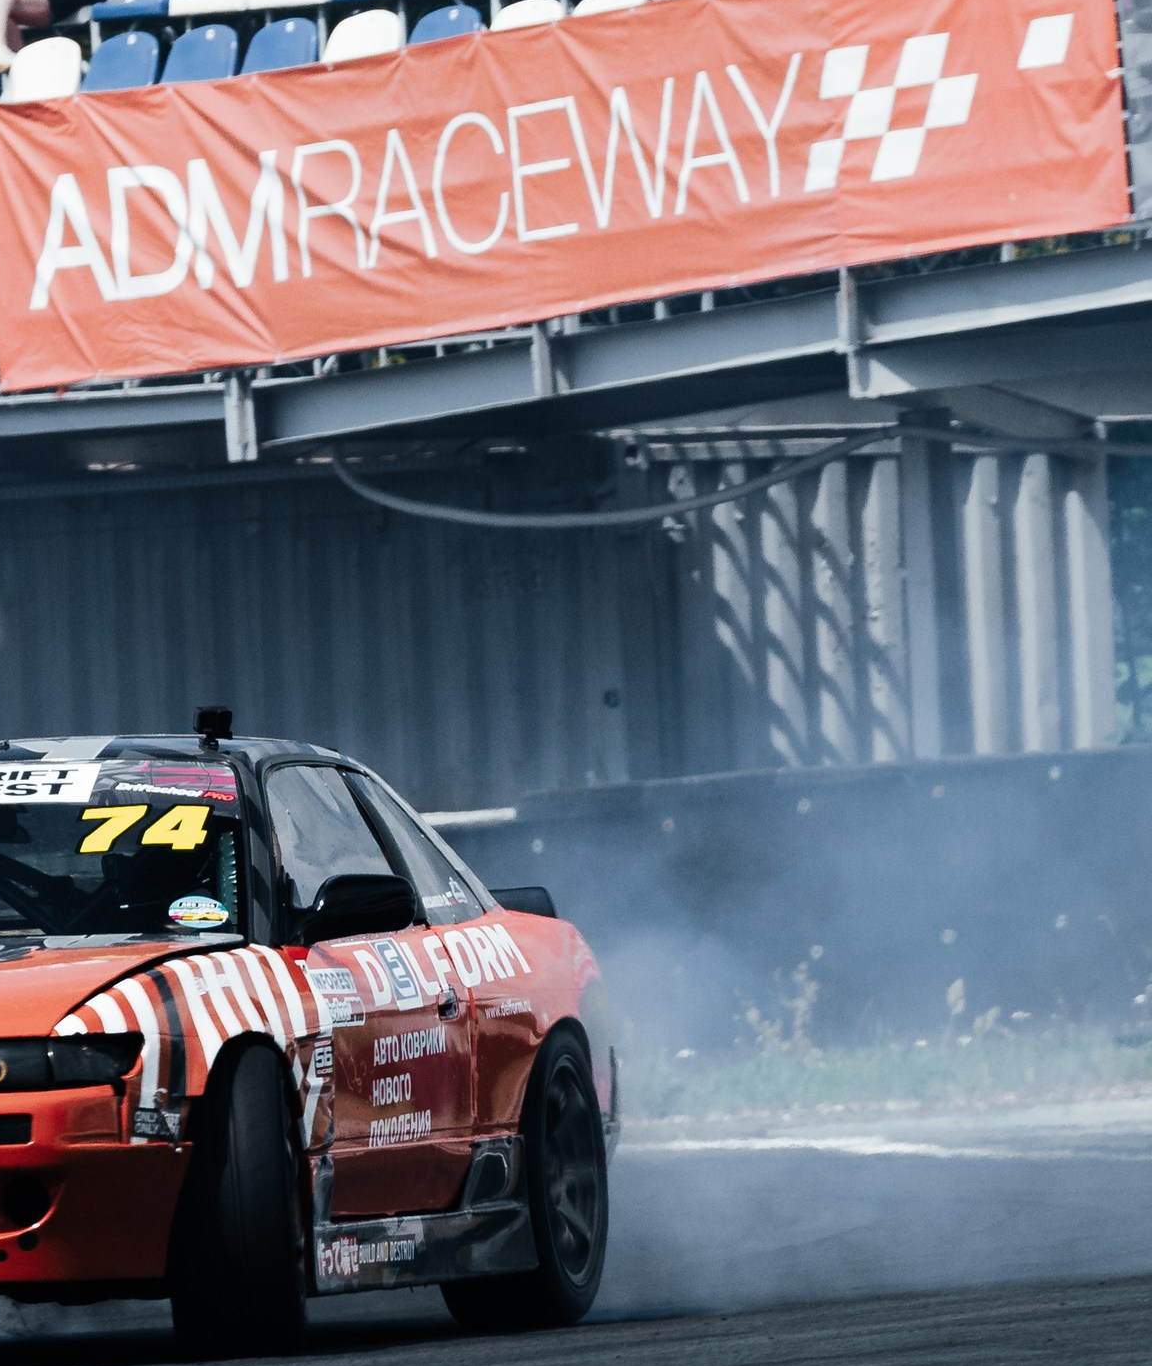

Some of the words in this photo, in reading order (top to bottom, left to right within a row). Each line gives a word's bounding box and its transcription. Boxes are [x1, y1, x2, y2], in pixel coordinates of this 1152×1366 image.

[203, 790, 236, 803] PRO
[78, 803, 211, 855] 74
[352, 923, 532, 1011] DELFORM
[373, 1034, 399, 1067] АВТО
[400, 1024, 446, 1061] КОВРИКИ
[372, 1072, 412, 1107] НОВОГО
[368, 1109, 432, 1148] ПОКОЛЕНИЯ
